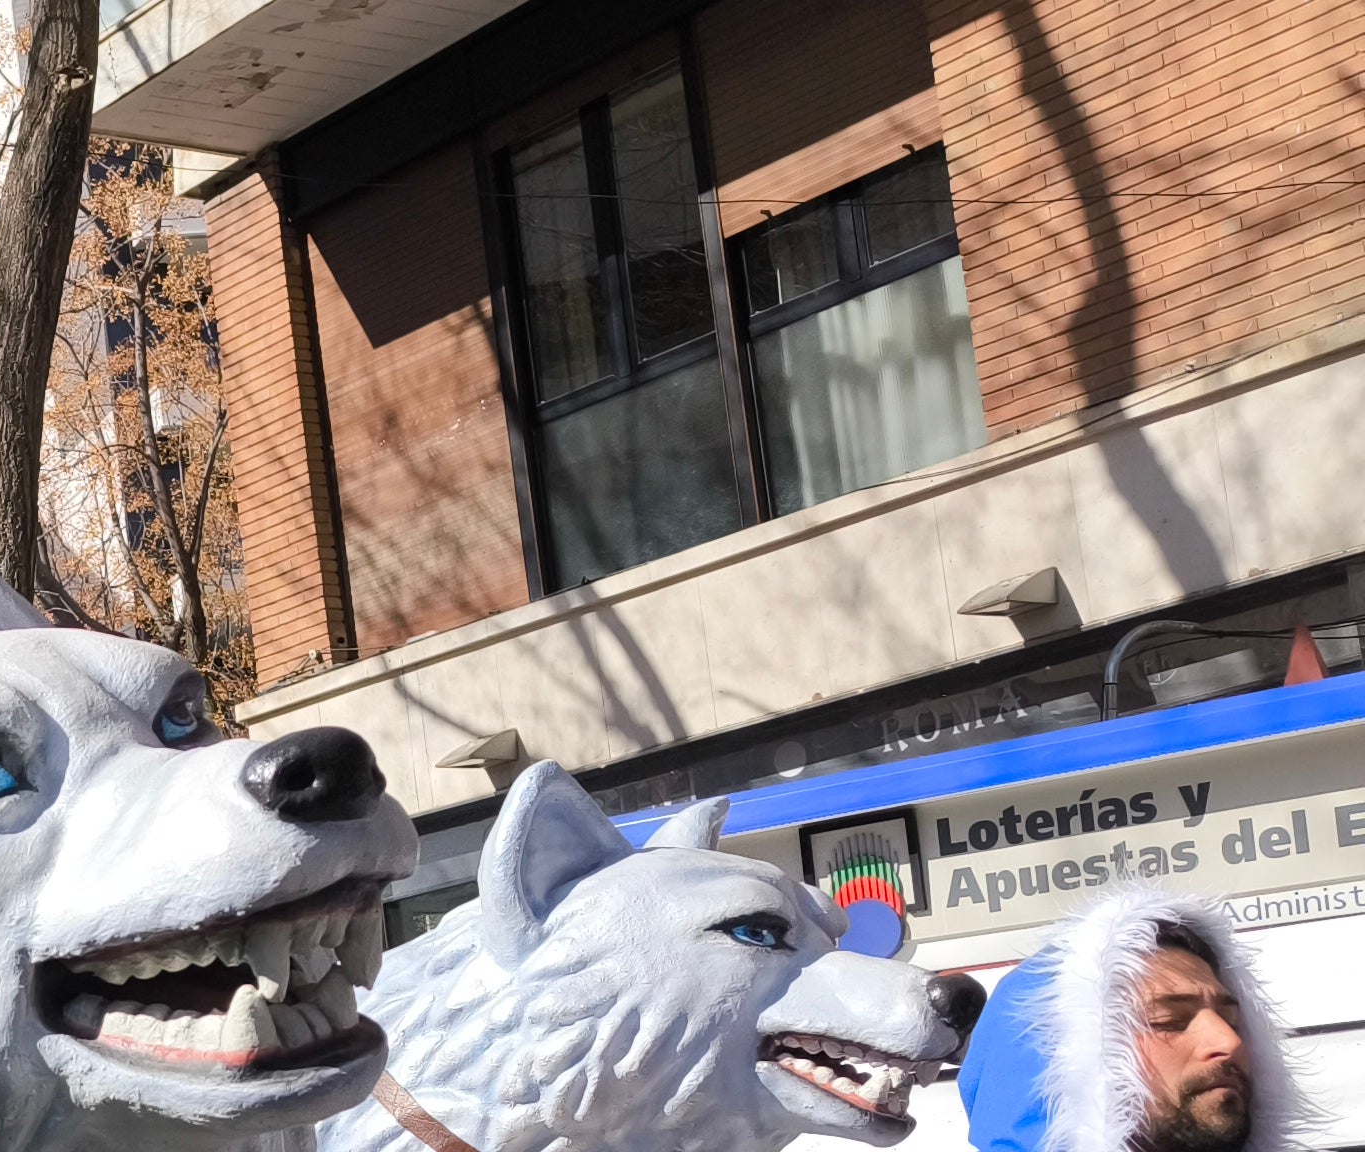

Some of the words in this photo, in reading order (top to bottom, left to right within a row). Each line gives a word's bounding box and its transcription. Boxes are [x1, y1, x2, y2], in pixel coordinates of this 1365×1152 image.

[880, 676, 1029, 754] ROMA
[937, 787, 1158, 857] Loterías
[1178, 780, 1212, 828] y
[945, 838, 1199, 913] Apuestas
[1220, 808, 1311, 865] del
